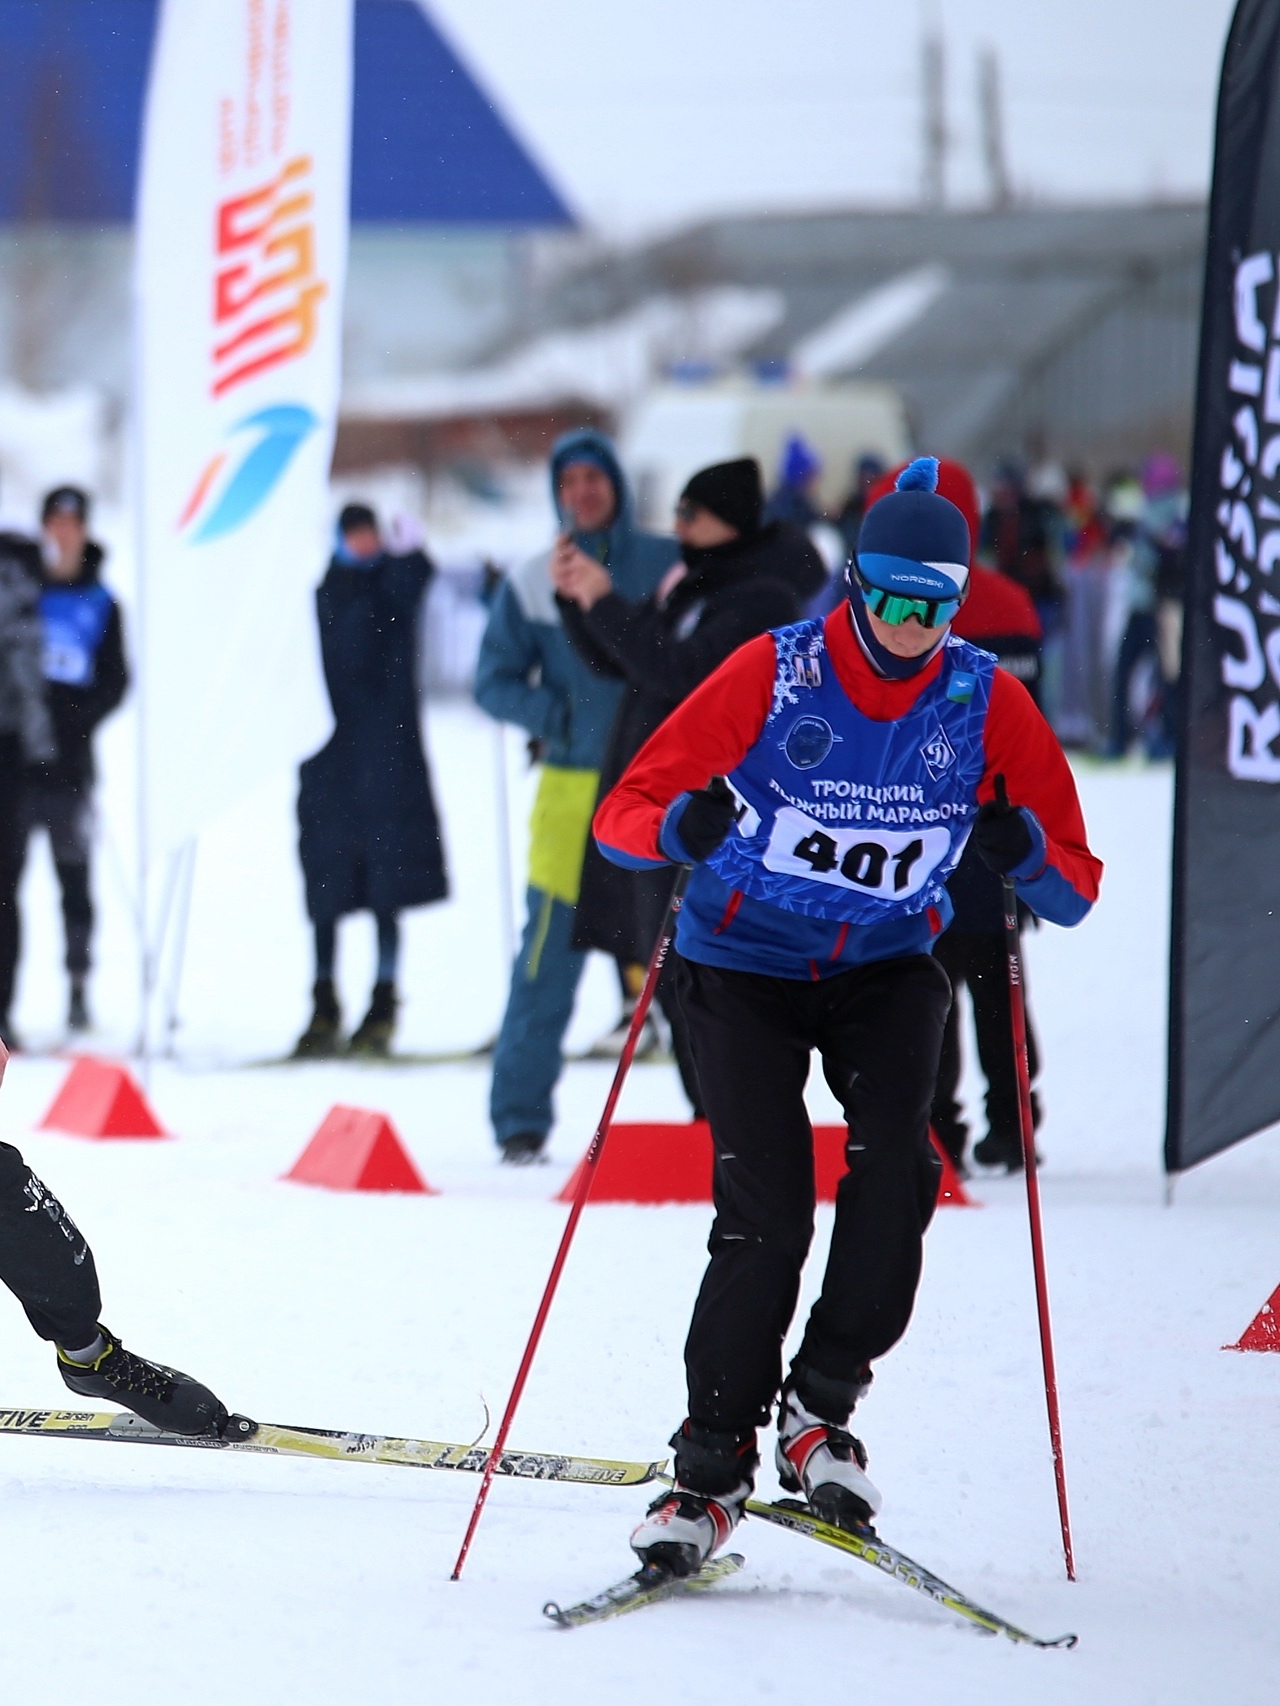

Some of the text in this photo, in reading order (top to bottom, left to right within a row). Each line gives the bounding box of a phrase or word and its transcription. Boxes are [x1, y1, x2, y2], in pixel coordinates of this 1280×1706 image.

[1214, 250, 1280, 784] RUSSIA
[890, 574, 945, 589] NORDSKI
[811, 779, 925, 804] ТРОИЦКИЙ
[866, 803, 970, 824] МАРАФОН
[792, 829, 924, 893] 401
